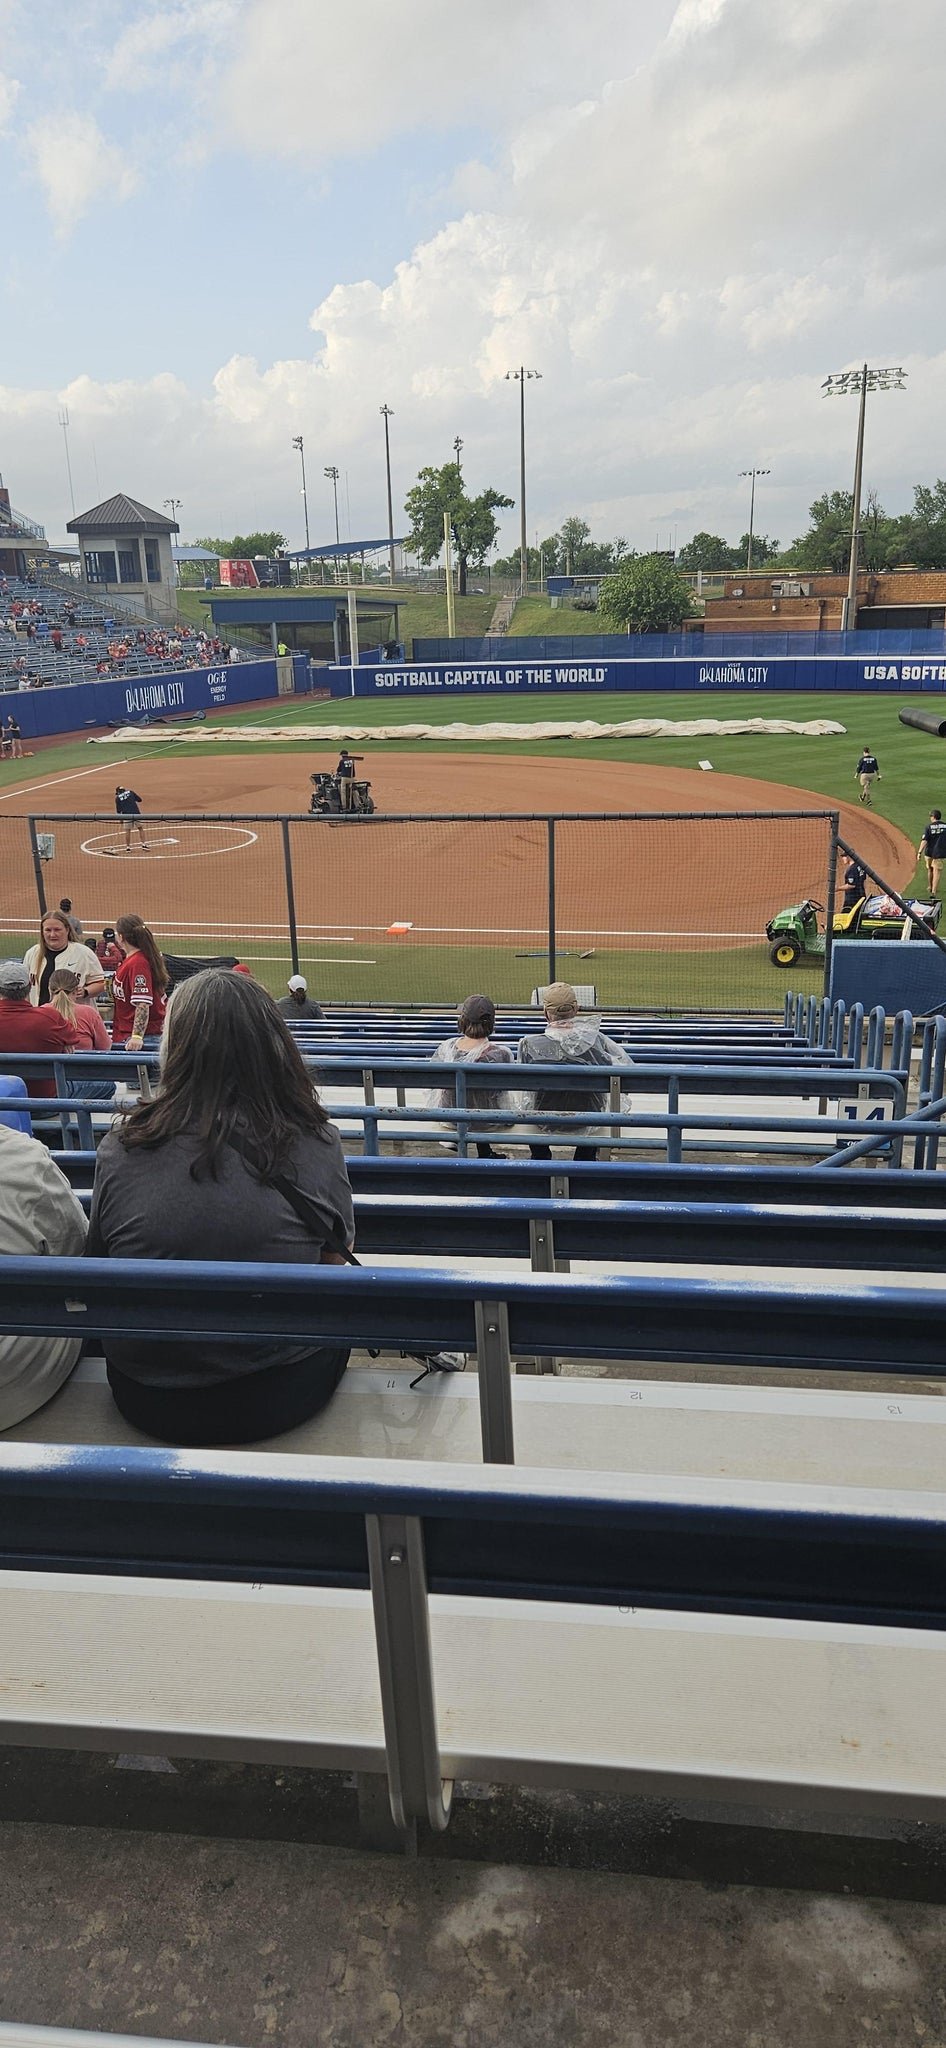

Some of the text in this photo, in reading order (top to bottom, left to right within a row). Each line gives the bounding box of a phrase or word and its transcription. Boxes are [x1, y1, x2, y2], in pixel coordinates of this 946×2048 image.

[374, 671, 442, 688] SOFTBALL
[444, 670, 503, 685] CAPITAL
[505, 670, 523, 684] OF
[525, 669, 552, 684] THE
[699, 664, 769, 683] OKLAHOMA CITY
[863, 666, 899, 680] USA
[210, 685, 227, 694] ENERGY
[125, 681, 185, 713] OKLAHOMA CITY
[213, 694, 226, 703] FIELD
[630, 1391, 643, 1400] 12
[887, 1405, 903, 1415] 13
